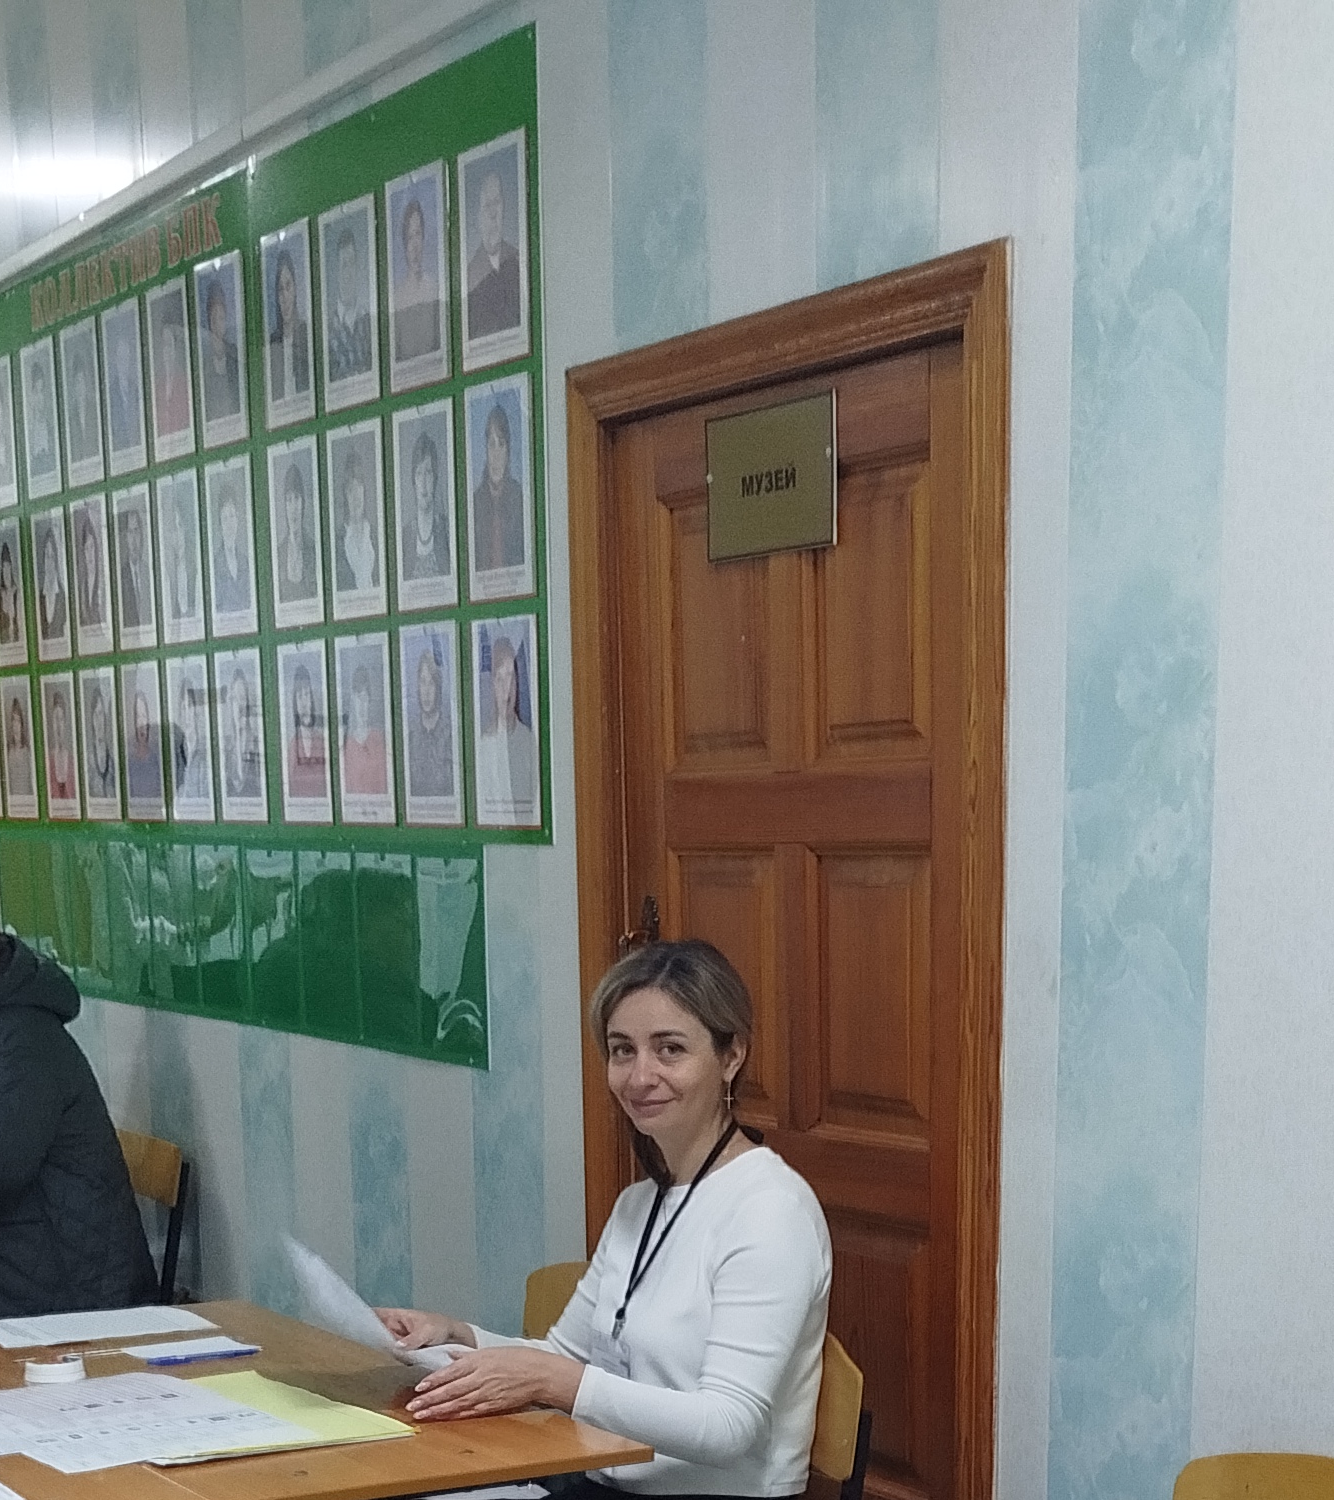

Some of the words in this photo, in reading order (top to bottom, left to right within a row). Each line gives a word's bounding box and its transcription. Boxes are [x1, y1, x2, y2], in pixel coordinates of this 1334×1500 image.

[30, 224, 161, 332] КОЛЛЕКТИВ
[166, 192, 223, 268] БПК
[740, 462, 797, 498] МУЗЕЙ
